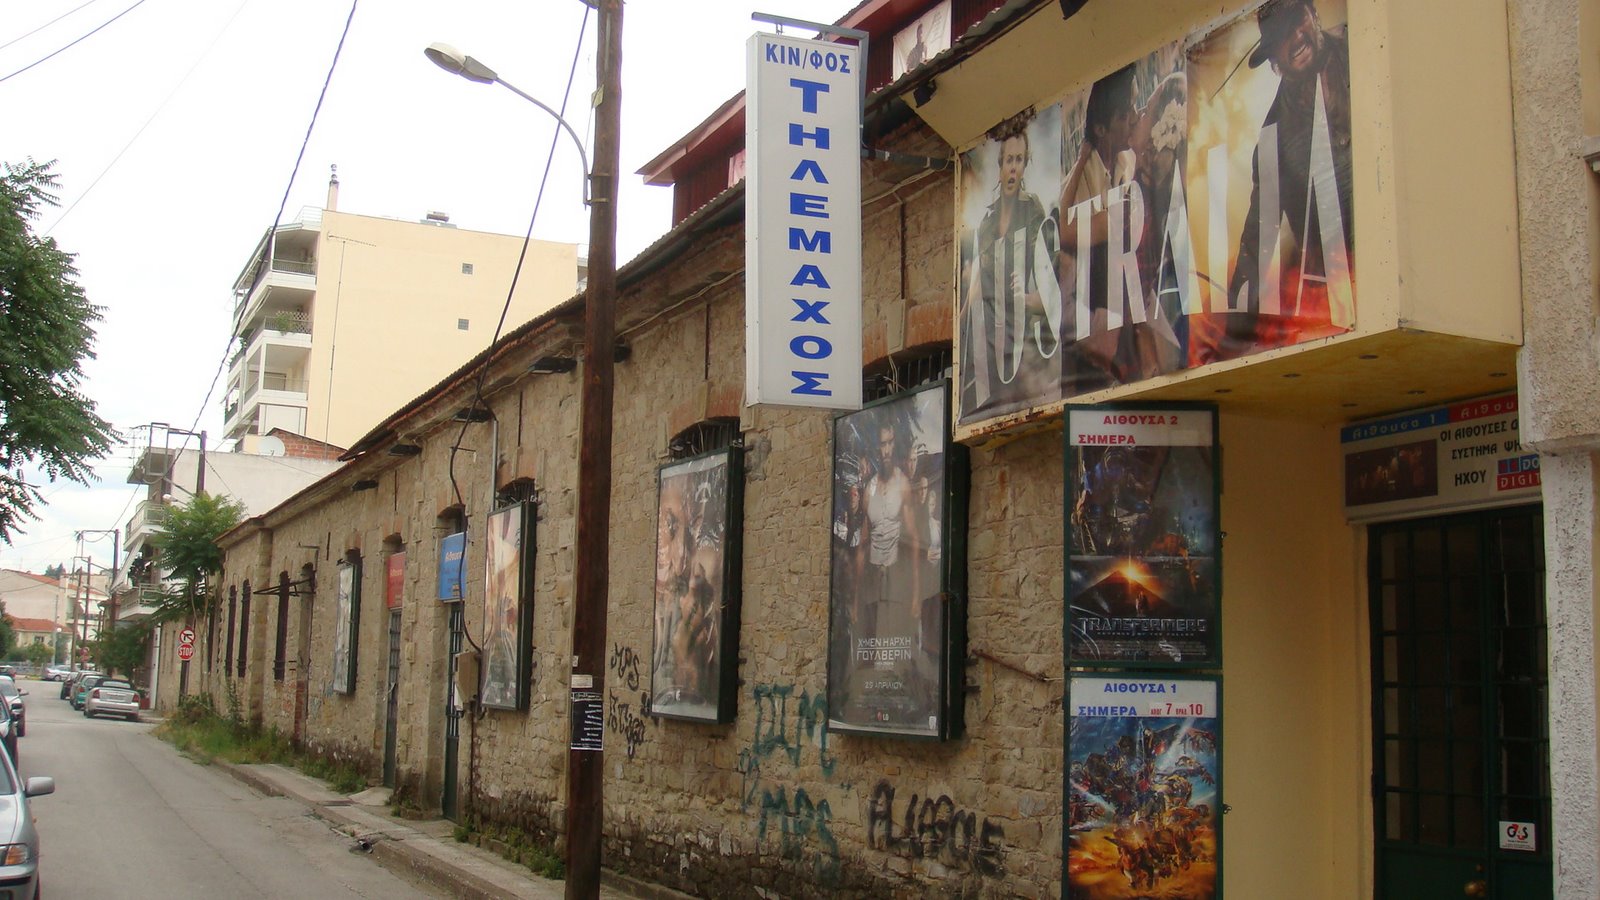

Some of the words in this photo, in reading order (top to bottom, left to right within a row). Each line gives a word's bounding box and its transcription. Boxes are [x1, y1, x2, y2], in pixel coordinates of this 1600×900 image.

[766, 43, 850, 74] ΚΙΝ/ΦΟΣ
[789, 78, 832, 396] ΤΗΛΕΜΑΧΟΣ
[958, 73, 1355, 410] AUSTRALIA
[1103, 415, 1166, 425] ΑΙΘΟΥΣΑ
[1170, 415, 1178, 425] 2
[1430, 414, 1435, 424] 1
[1440, 430, 1451, 442] ΟΙ
[1454, 420, 1507, 440] ΑΙΘΟΥΣΕΣ
[1078, 434, 1136, 444] ΣΗΜΕΡΑ
[1452, 443, 1498, 460] ΣΥΣΤΗΜΑ
[1454, 469, 1486, 486] ΗΧΟΥ
[179, 647, 193, 656] STOP
[857, 650, 912, 661] ΓΟΥΛΒΕΡΙΝ
[1104, 683, 1165, 694] ΑΙΘΟΥΣΑ
[1171, 684, 1177, 693] 1
[1078, 706, 1137, 717] ΣΗΜΕΡΑ
[1166, 703, 1172, 715] 7
[1189, 703, 1203, 715] 10
